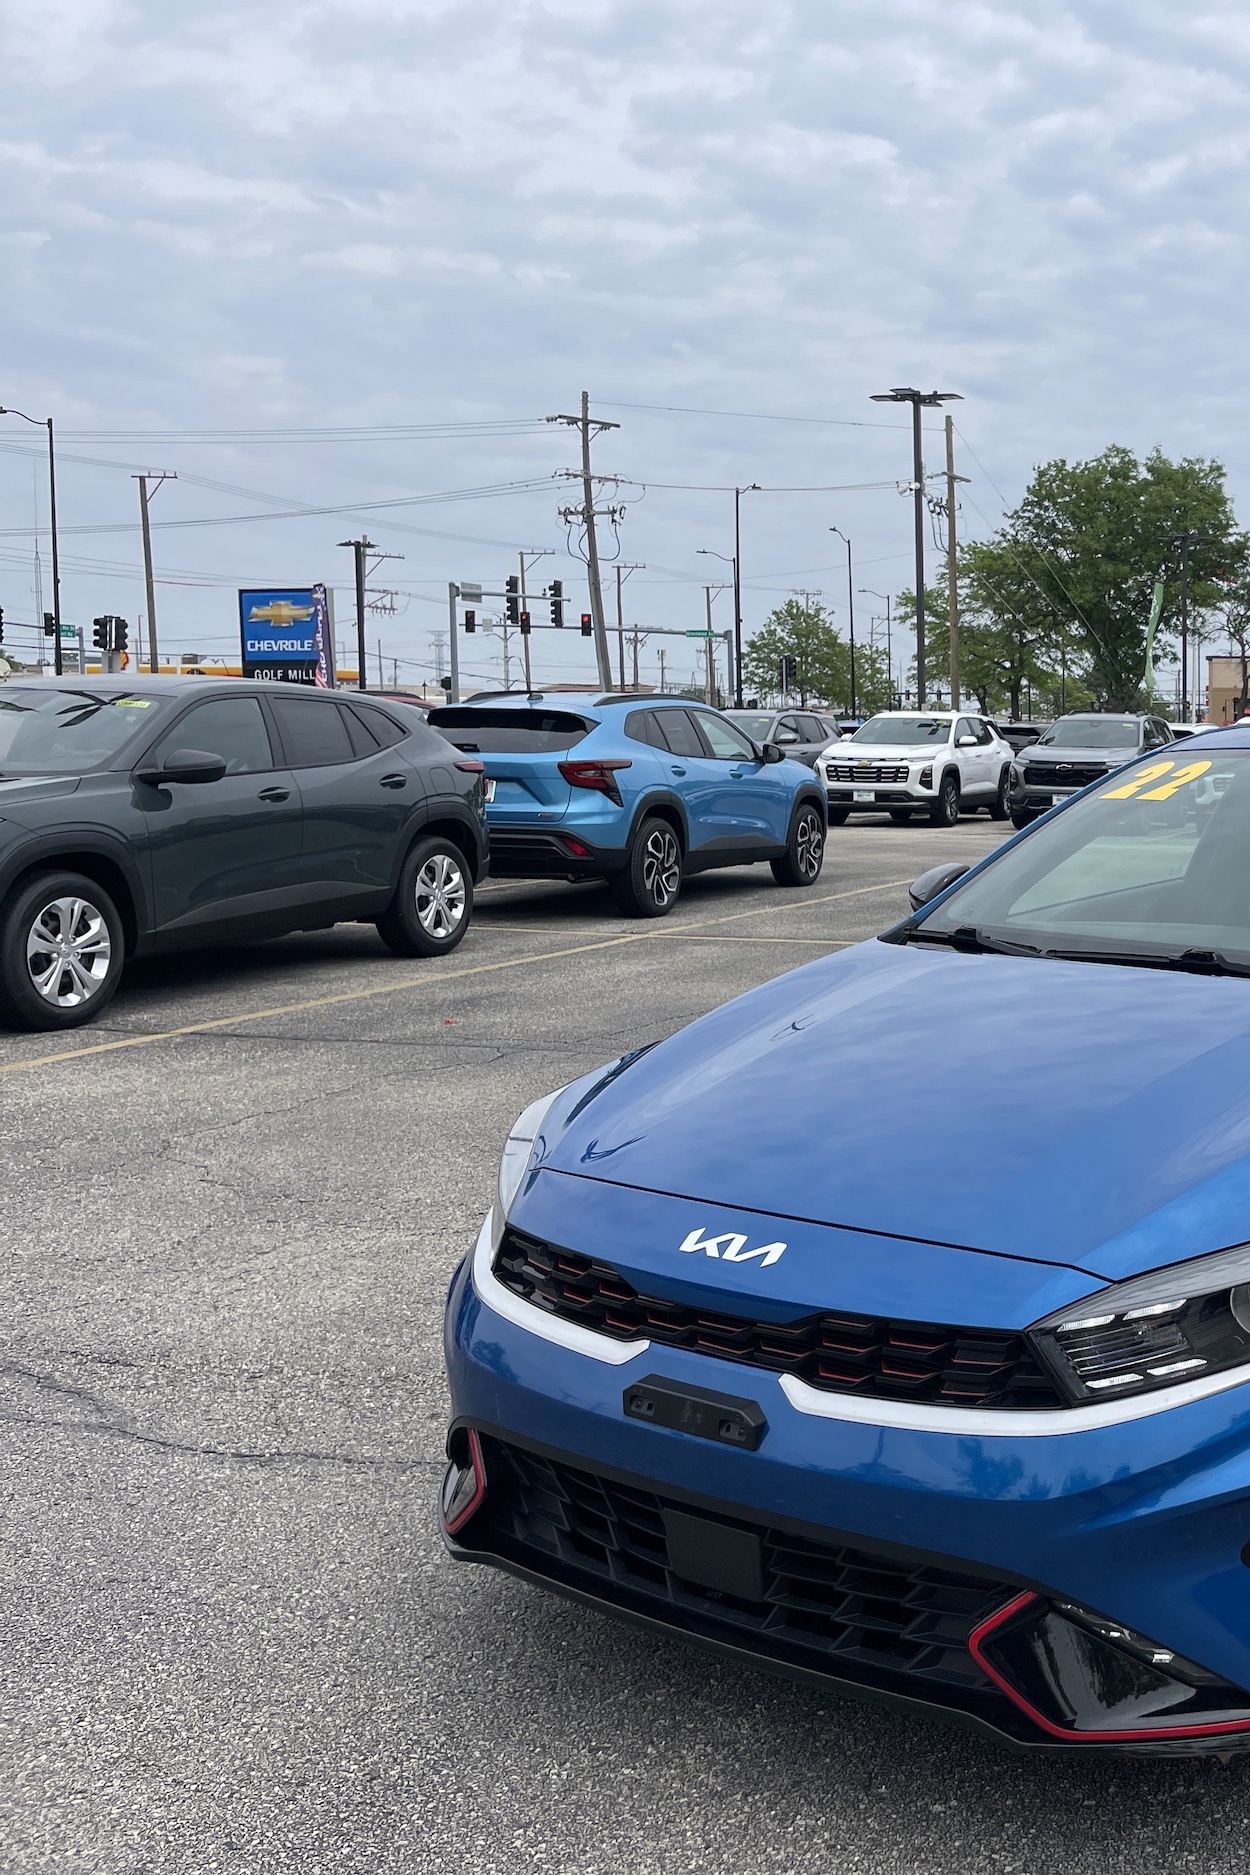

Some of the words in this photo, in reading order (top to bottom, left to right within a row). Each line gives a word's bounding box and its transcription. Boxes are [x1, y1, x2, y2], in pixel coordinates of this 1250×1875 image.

[247, 640, 316, 652] CHEVROLE
[254, 669, 283, 681] GOLF
[288, 669, 315, 680] MILL
[1098, 760, 1213, 801] 22
